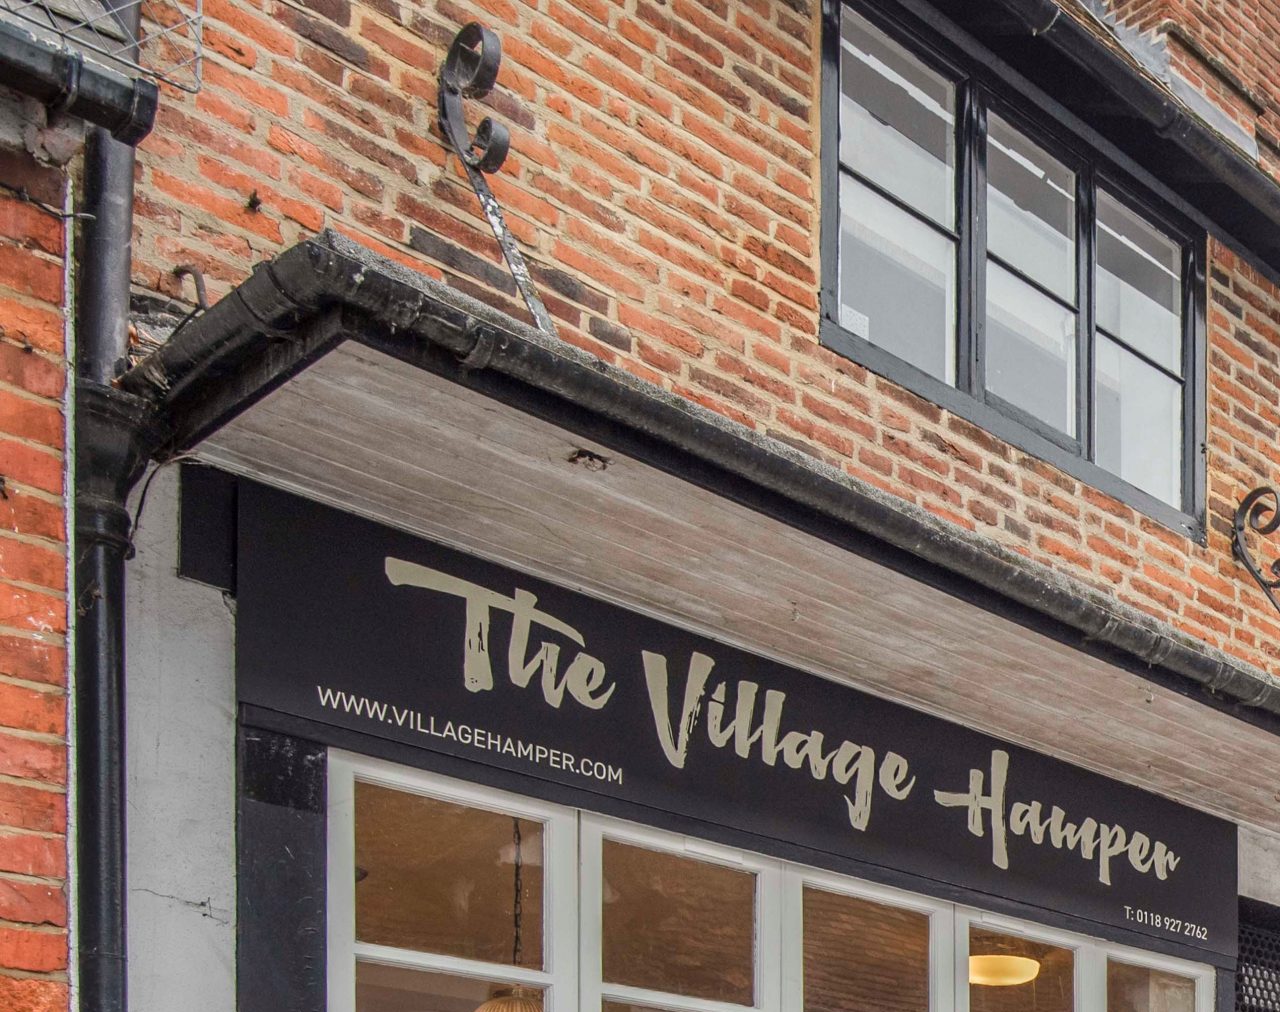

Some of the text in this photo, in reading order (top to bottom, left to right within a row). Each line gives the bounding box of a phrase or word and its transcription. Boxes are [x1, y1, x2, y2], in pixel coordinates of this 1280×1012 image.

[317, 685, 623, 785] WWW.VILLAGEHAMPER.COM
[385, 556, 1181, 885] The Village Hamper
[1123, 905, 1208, 940] T: 0118 927 2762
